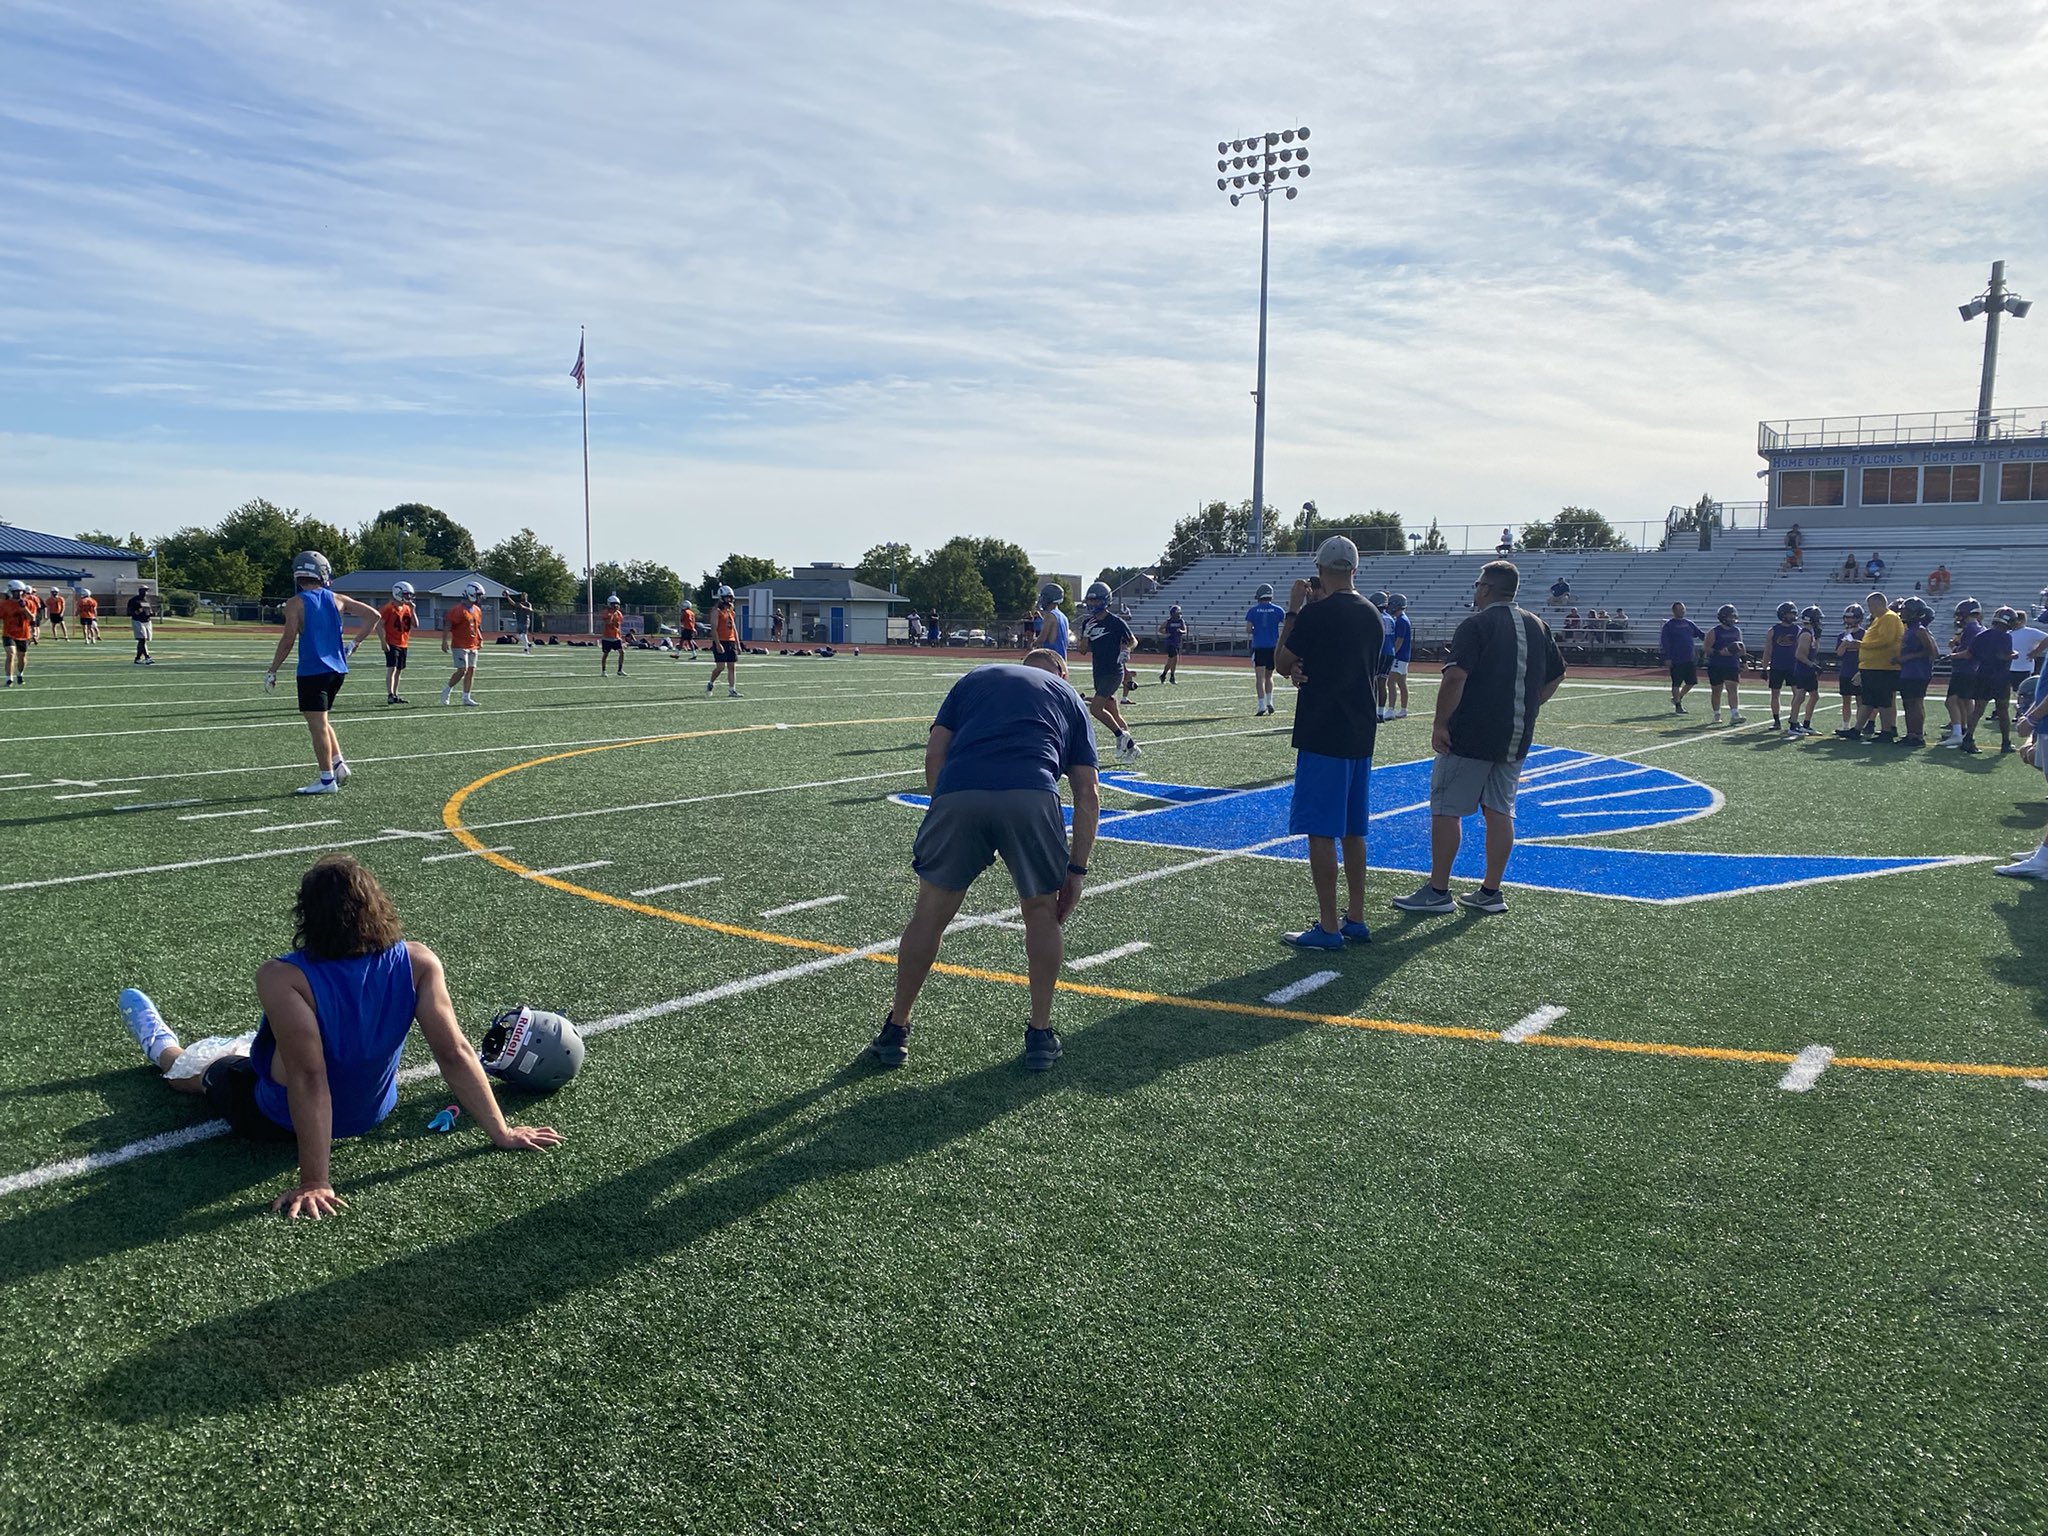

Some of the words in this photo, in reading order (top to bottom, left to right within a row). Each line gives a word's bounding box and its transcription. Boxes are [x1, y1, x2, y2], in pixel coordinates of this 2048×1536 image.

[1773, 458, 1804, 468] HOME
[1808, 456, 1821, 467] OF
[1825, 456, 1847, 466] THE
[1852, 454, 1903, 464] FALCONS
[1923, 451, 1956, 462] HOME
[1962, 450, 1977, 461] OF
[1983, 449, 2005, 460] THE
[505, 1017, 529, 1057] Riddell
